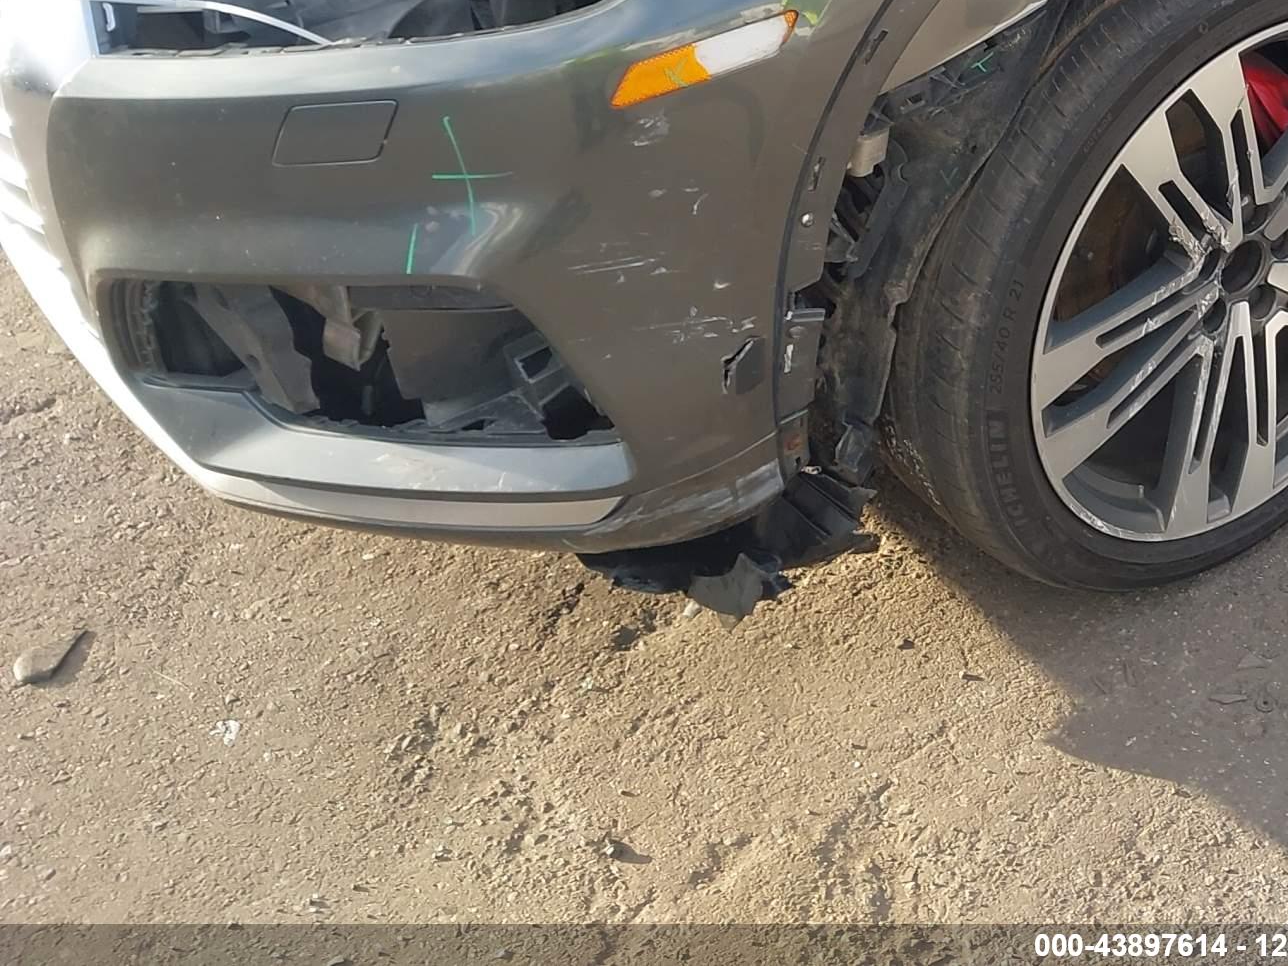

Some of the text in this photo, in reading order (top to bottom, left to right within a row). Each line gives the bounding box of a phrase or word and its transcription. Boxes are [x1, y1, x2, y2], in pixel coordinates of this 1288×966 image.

[989, 280, 1025, 395] 255/40 R 21
[988, 420, 1033, 531] ICHELIN
